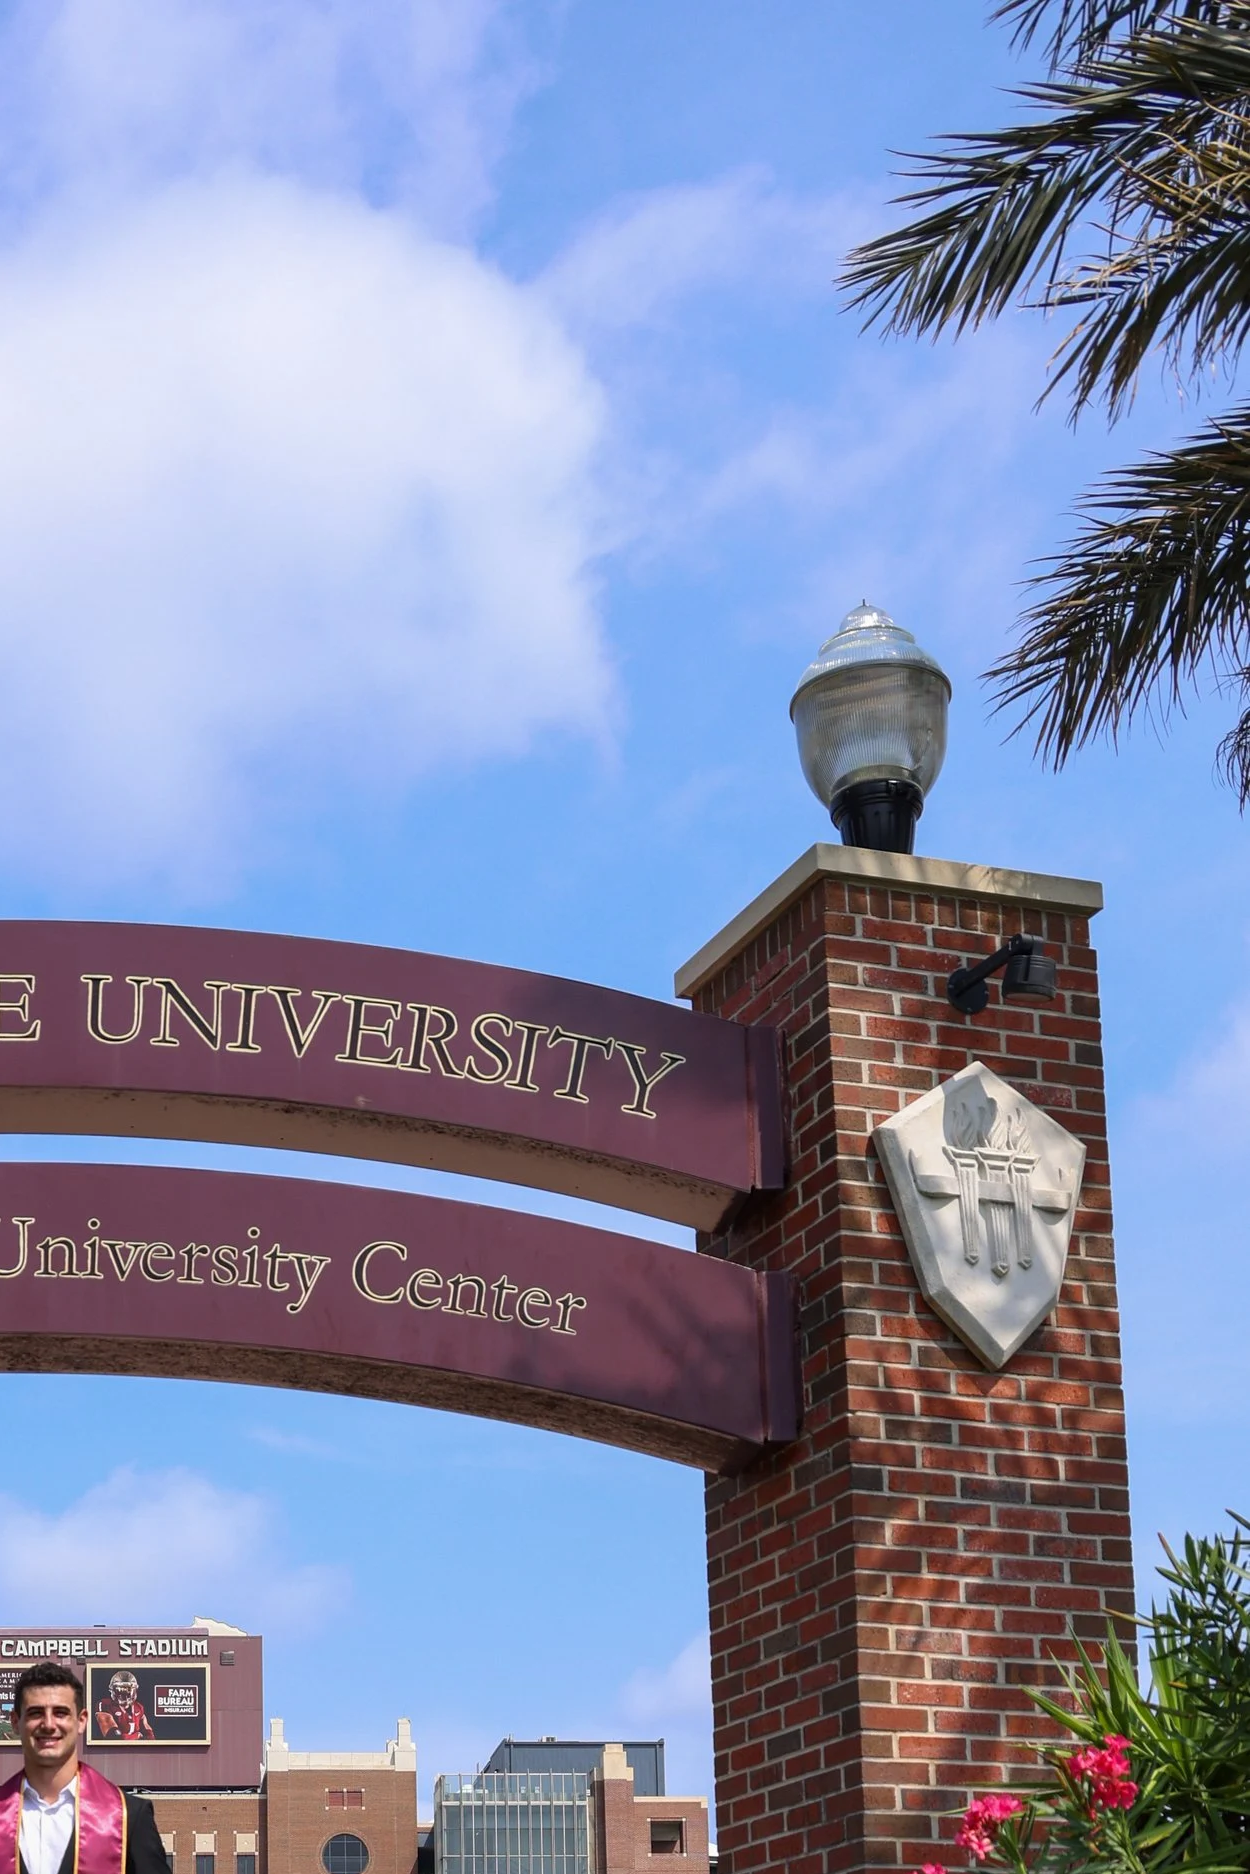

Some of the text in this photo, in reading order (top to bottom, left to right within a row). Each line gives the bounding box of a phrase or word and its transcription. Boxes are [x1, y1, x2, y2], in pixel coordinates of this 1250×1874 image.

[81, 974, 685, 1119] UNIVERSITY
[352, 1240, 586, 1335] Center
[1, 1638, 109, 1657] CAMPBELL
[119, 1638, 208, 1656] STADIUM
[158, 1697, 194, 1705] BUREAU
[168, 1688, 194, 1697] FARM
